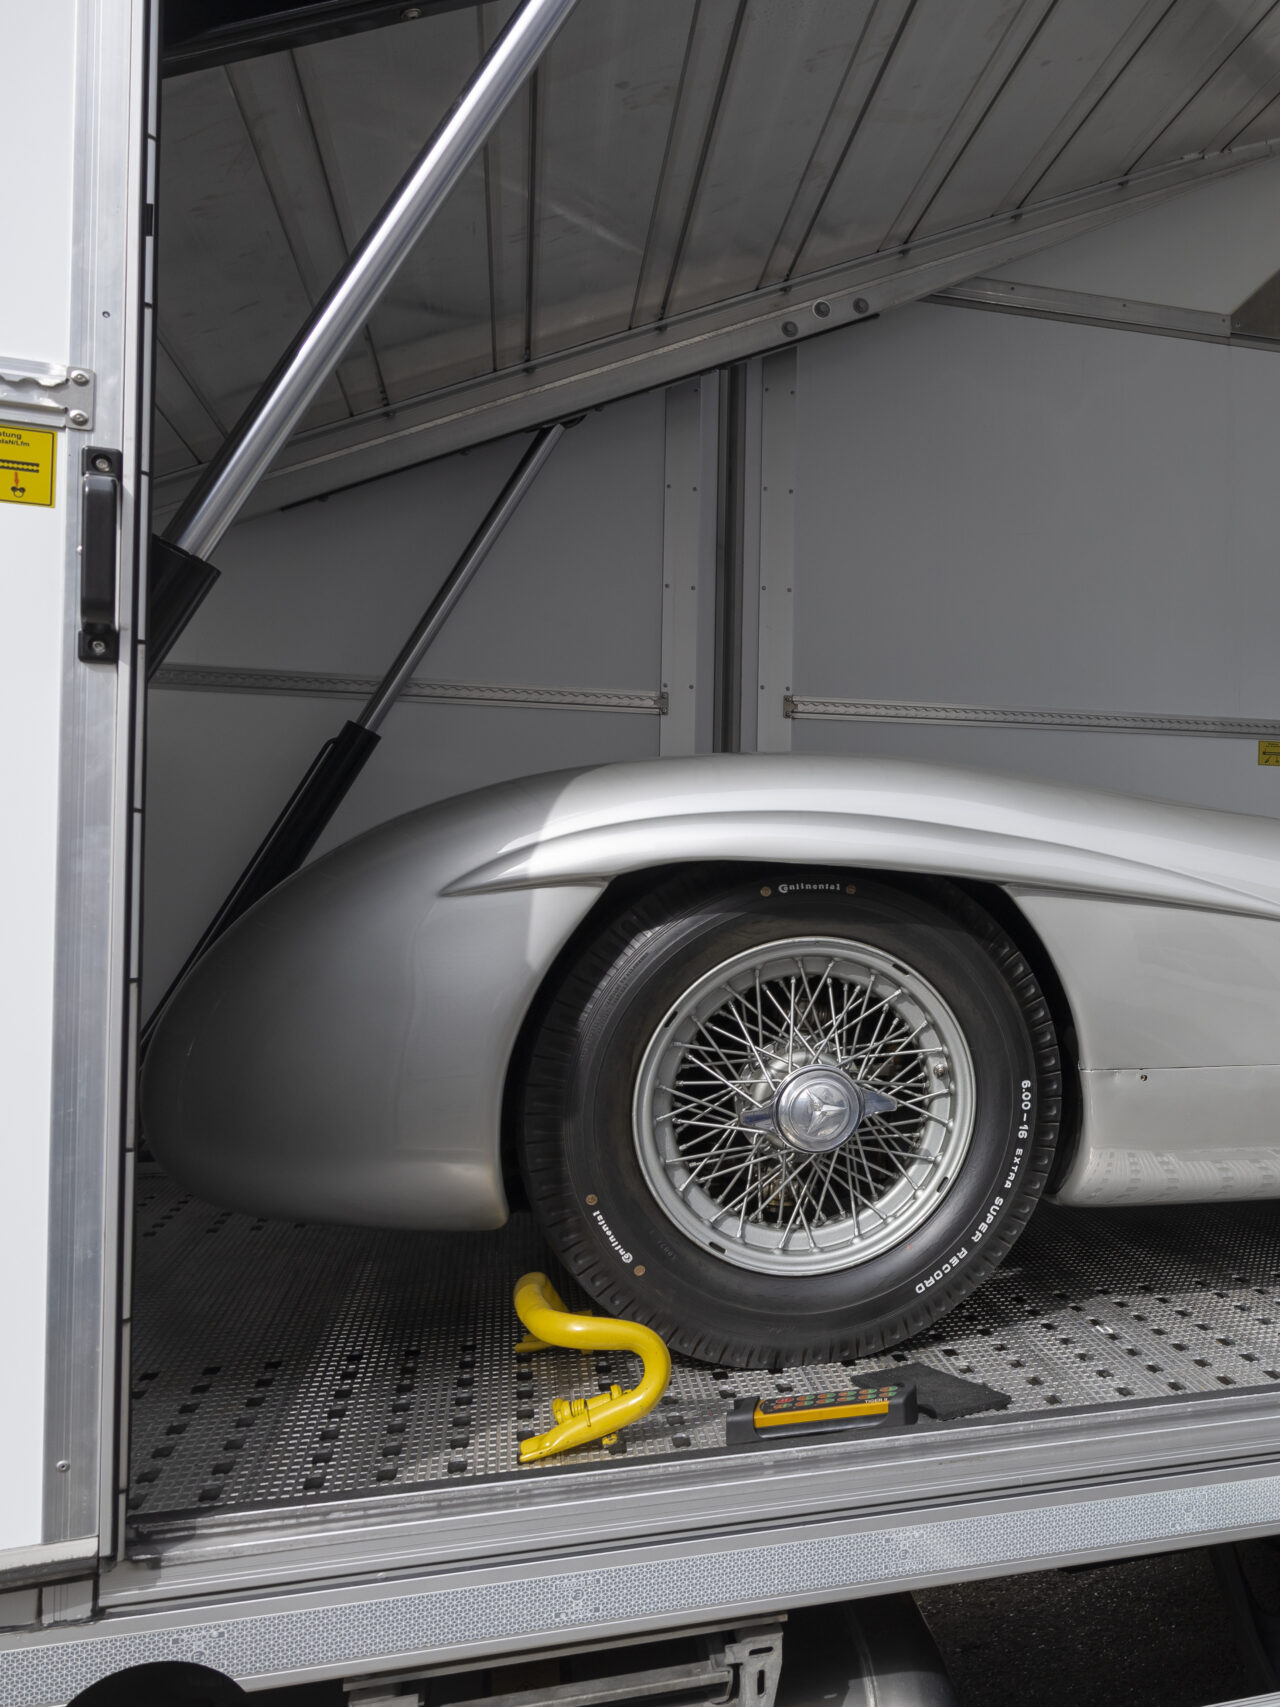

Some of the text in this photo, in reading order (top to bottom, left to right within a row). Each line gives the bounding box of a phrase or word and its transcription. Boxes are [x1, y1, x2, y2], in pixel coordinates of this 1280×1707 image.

[778, 883, 840, 893] Continental
[1004, 1148, 1023, 1189] EXTRA
[592, 1210, 633, 1263] Continental
[971, 1196, 1004, 1242] SUPER
[915, 1247, 968, 1294] RECORD
